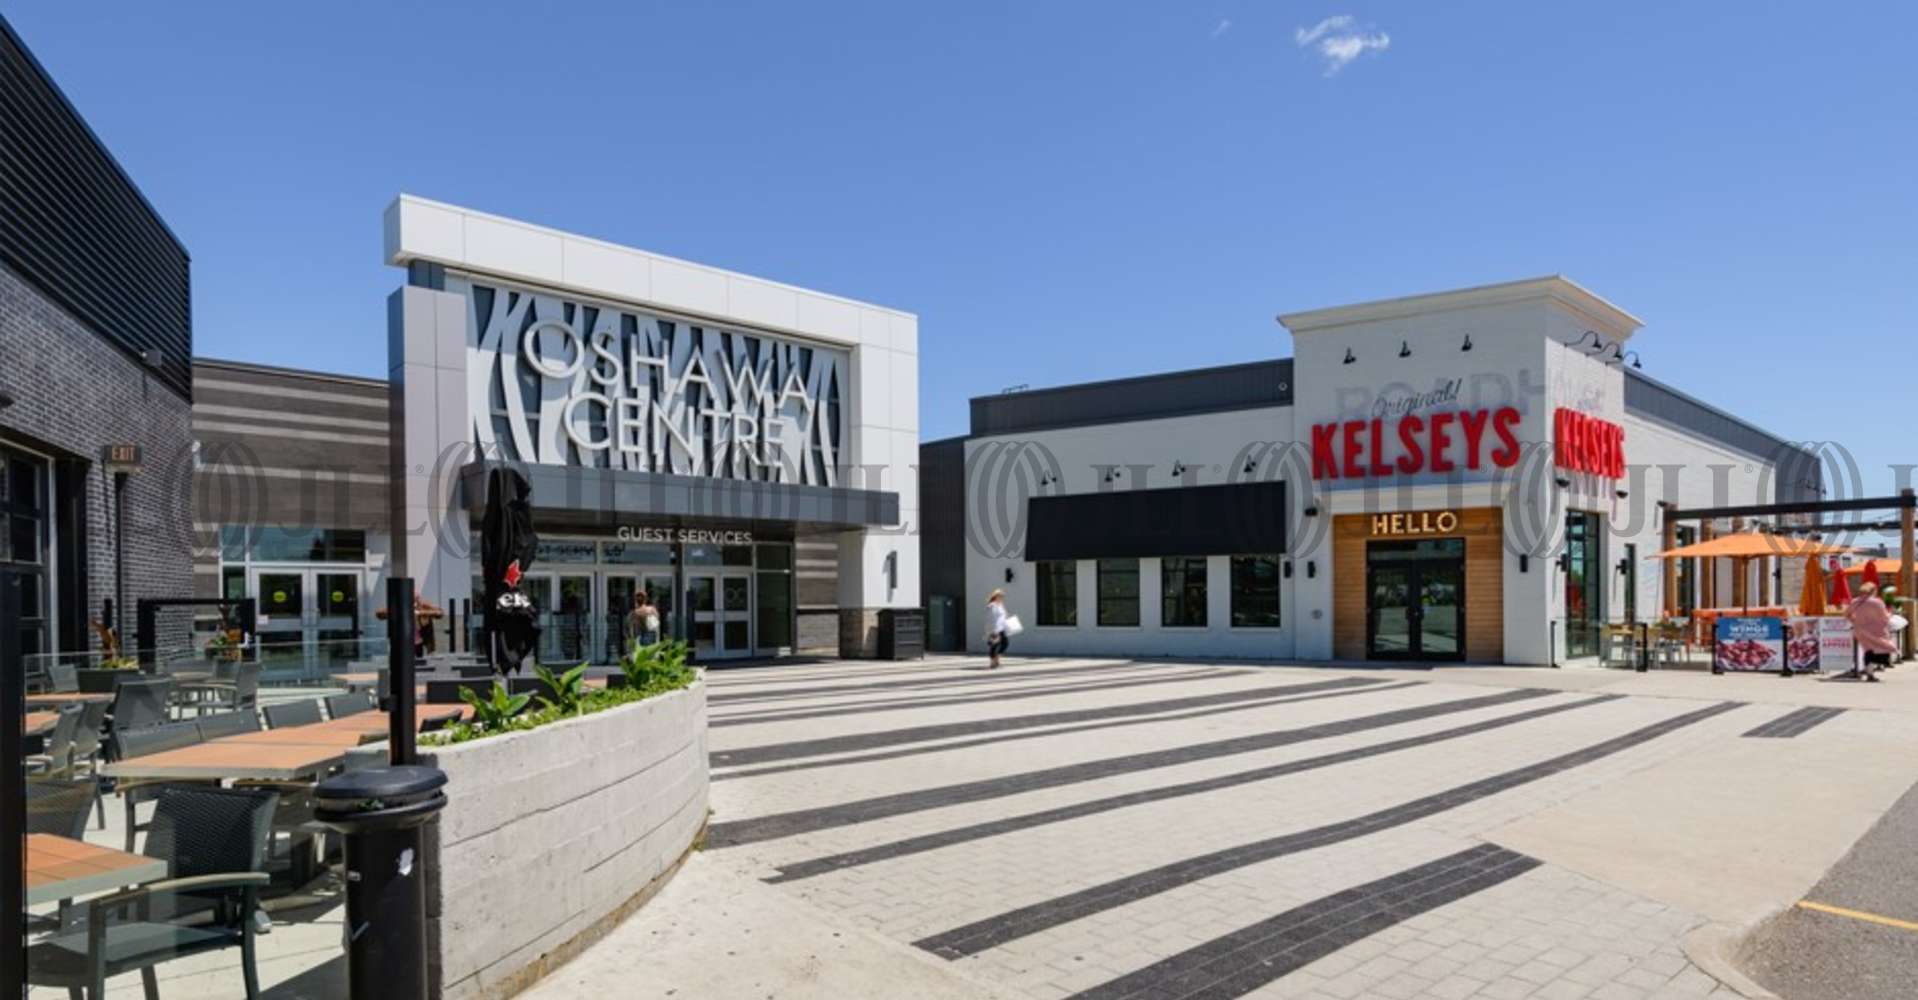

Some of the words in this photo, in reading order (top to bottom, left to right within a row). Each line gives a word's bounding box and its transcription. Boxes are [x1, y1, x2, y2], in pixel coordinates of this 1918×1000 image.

[524, 319, 812, 415] OSHAWA
[564, 391, 786, 468] CENTRE
[1311, 407, 1521, 480] KELSEYS
[1554, 408, 1626, 480] KELSEYS
[617, 526, 673, 542] GUEST
[678, 528, 752, 545] SERVICES
[1372, 512, 1457, 535] HELLO
